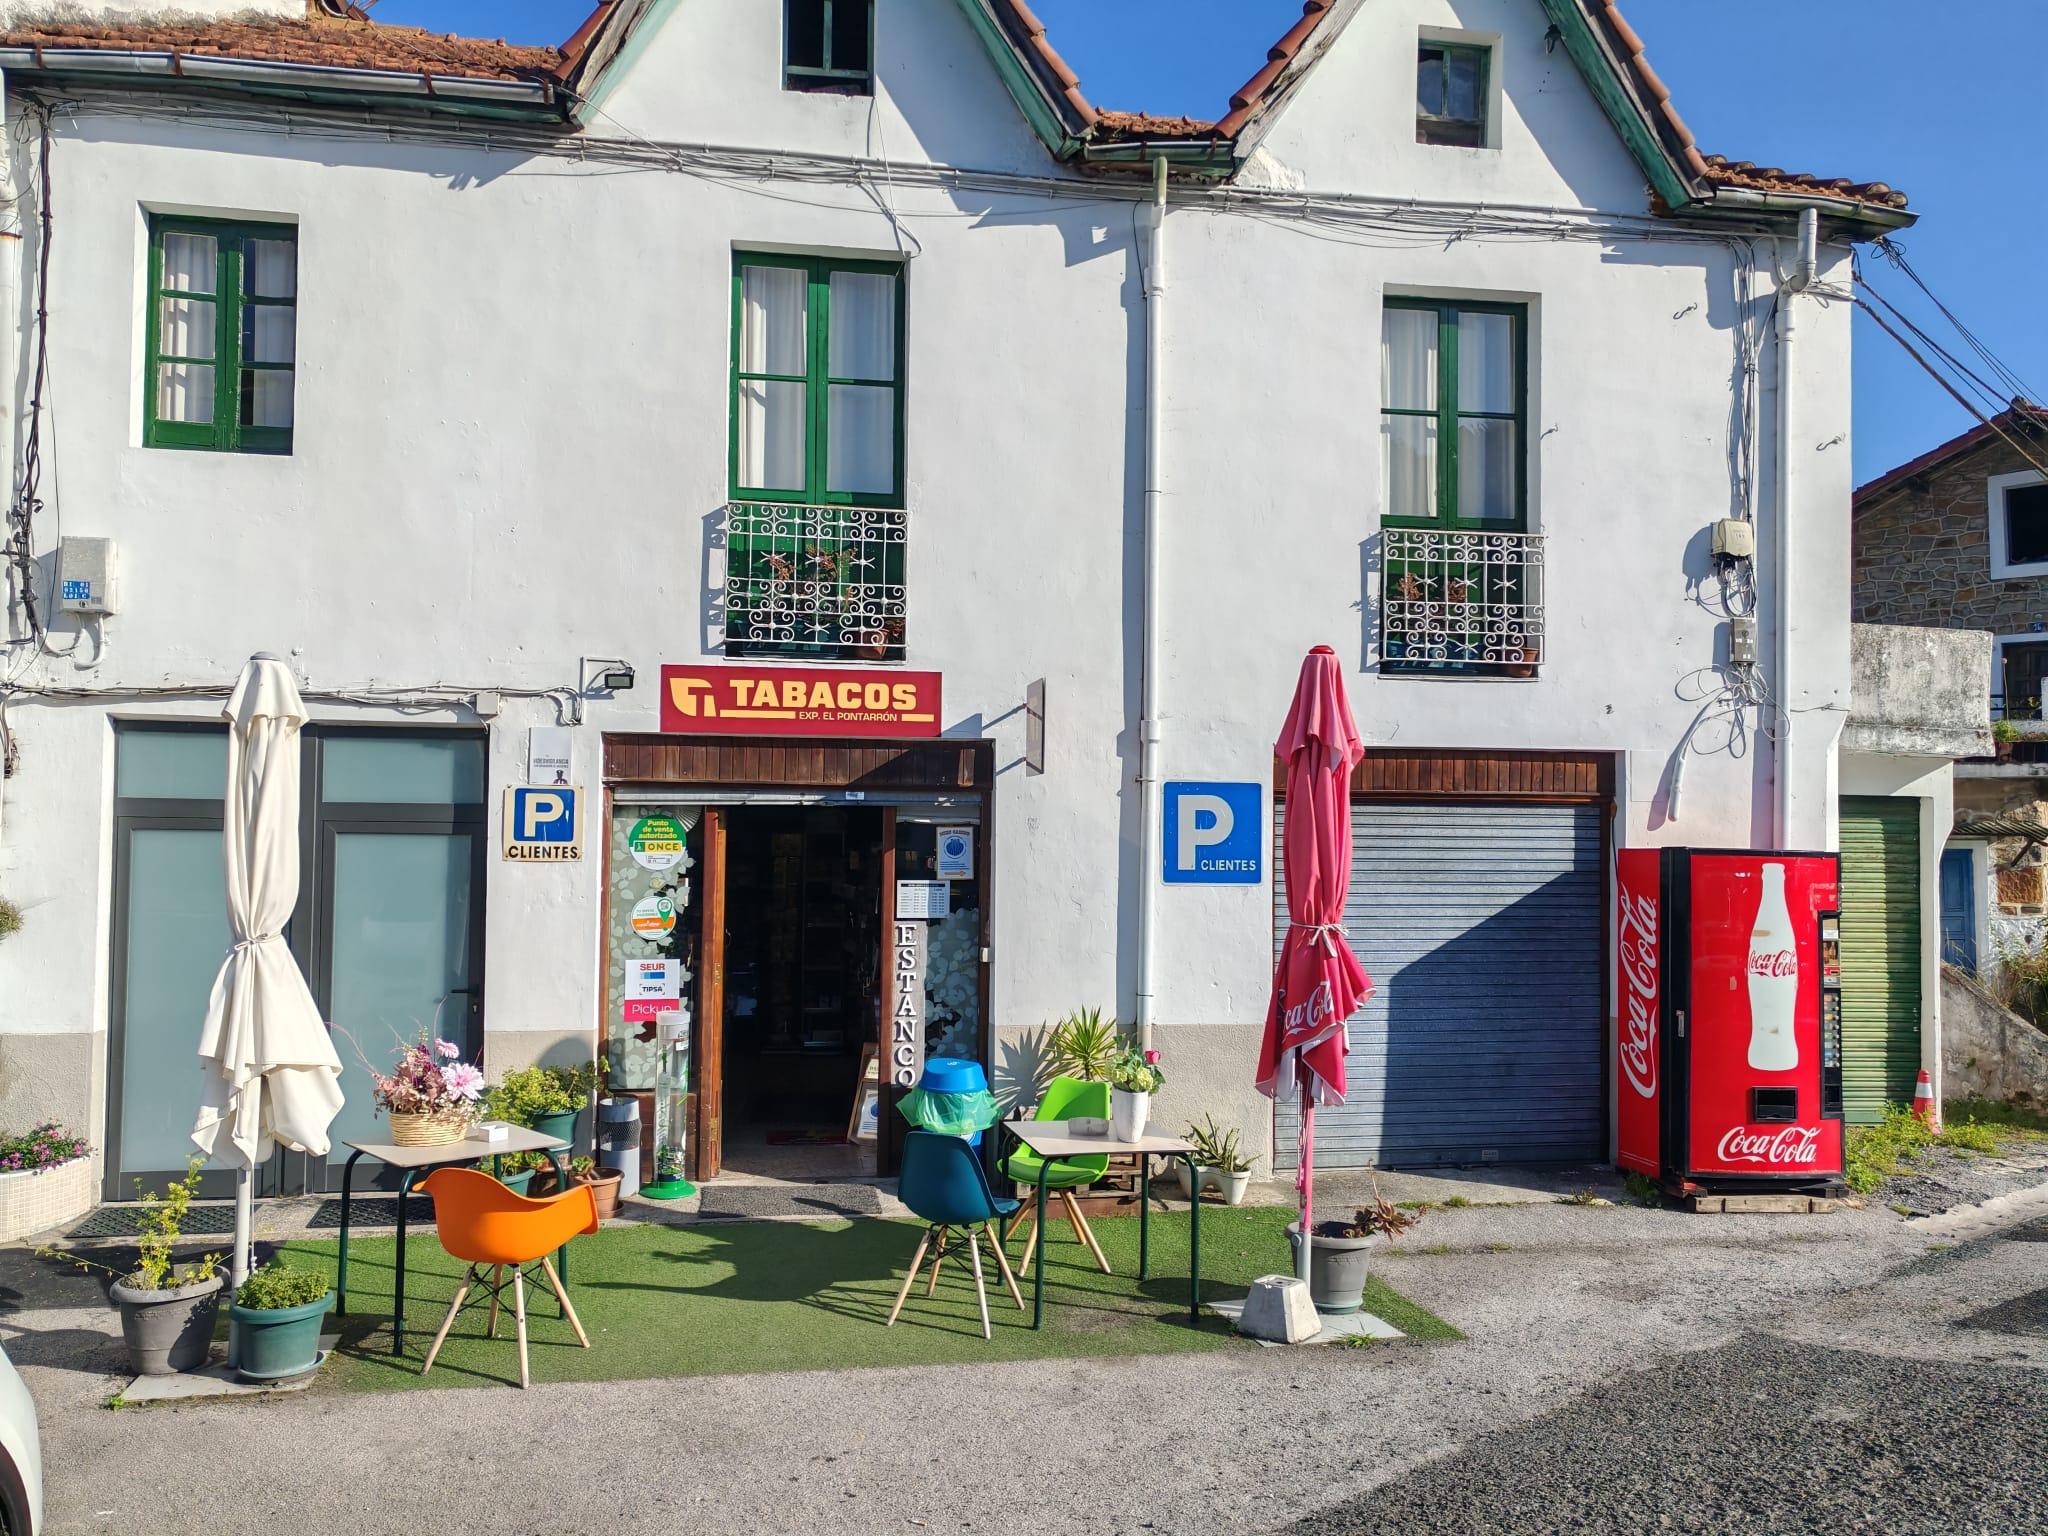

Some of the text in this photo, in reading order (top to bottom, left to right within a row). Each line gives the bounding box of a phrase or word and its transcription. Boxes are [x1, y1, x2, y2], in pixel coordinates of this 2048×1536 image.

[729, 679, 917, 711] TABACOS
[799, 711, 898, 722] EXP. EL PONTARRÓN
[524, 792, 565, 838] P
[647, 843, 681, 851] ONCE
[1177, 795, 1235, 871] P
[507, 845, 579, 860] CLIENTES
[1200, 859, 1257, 871] CLIENTES
[640, 963, 666, 971] SEUR
[1748, 948, 1797, 978] Coca-Cola
[1620, 879, 1657, 1099] Coca-Cola
[896, 923, 918, 1087] ESTANCO
[1717, 1125, 1823, 1163] Coca-Cola
